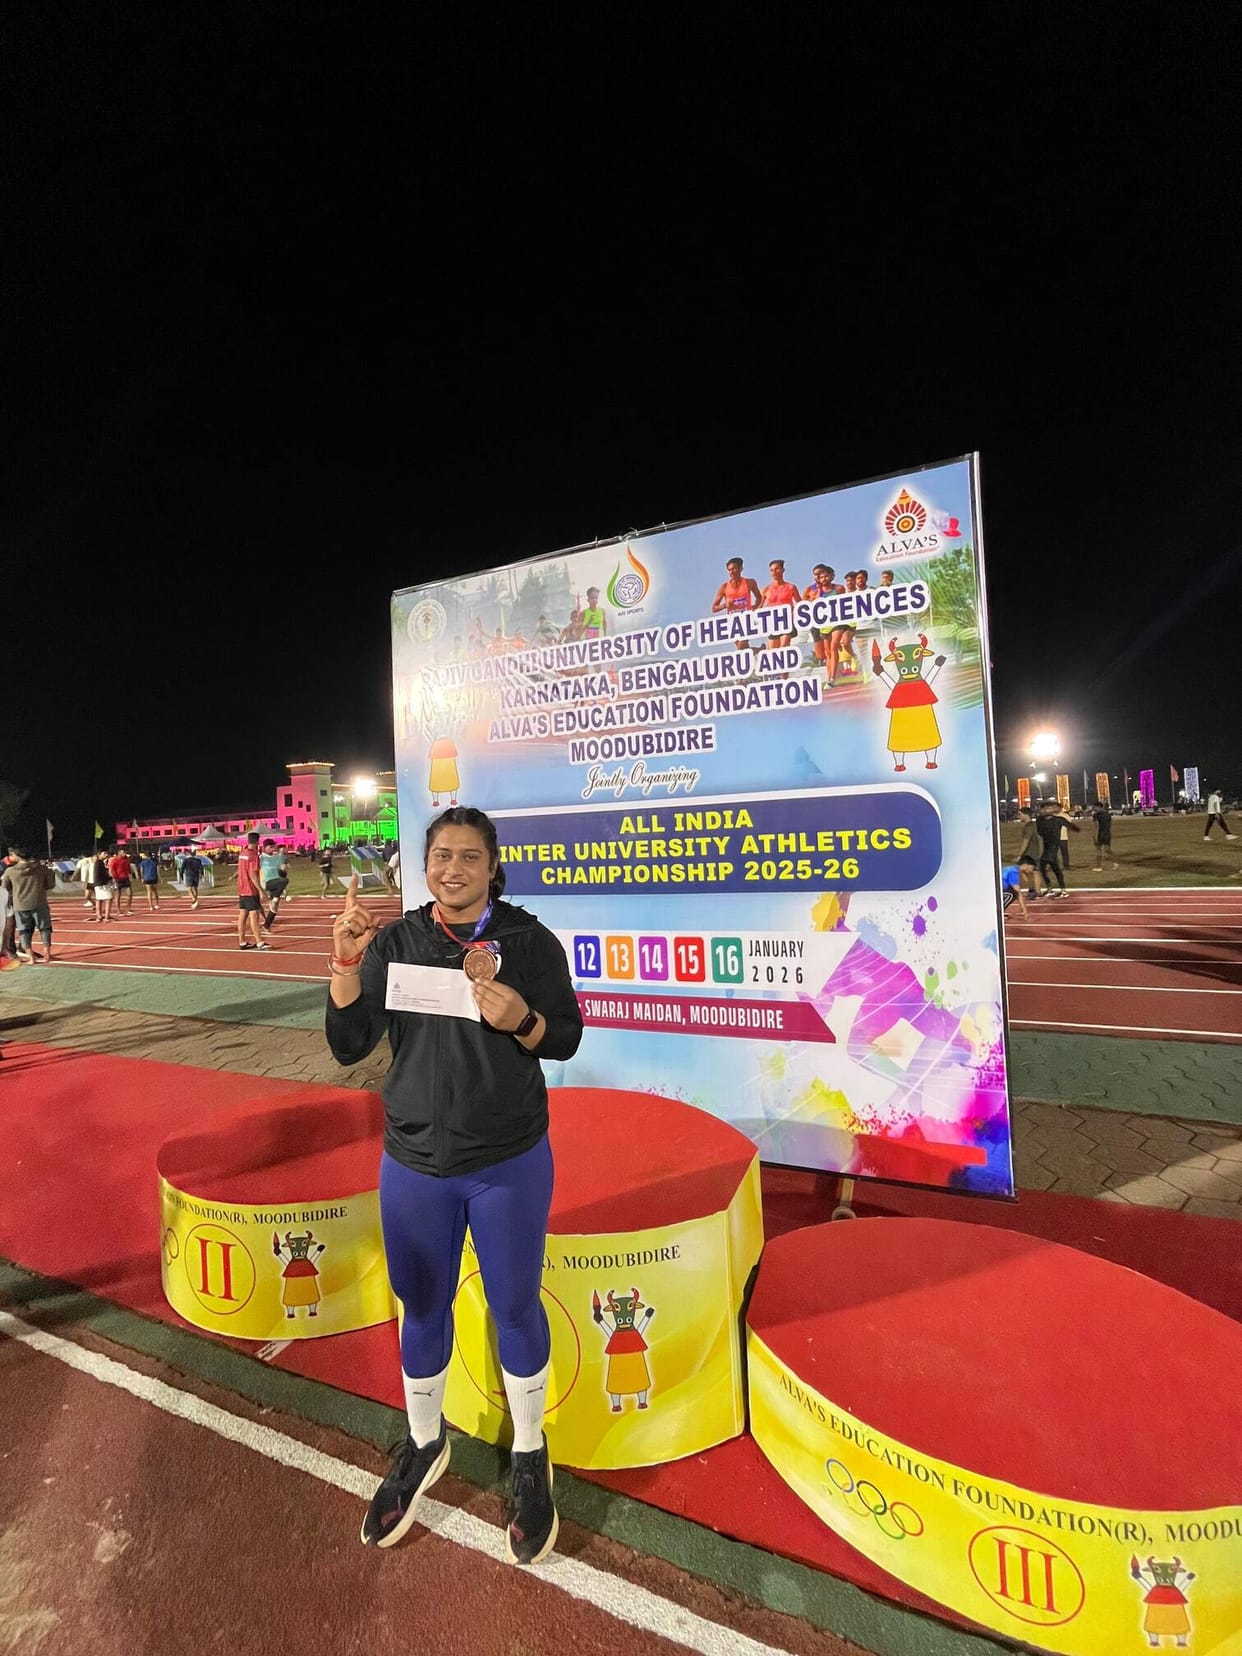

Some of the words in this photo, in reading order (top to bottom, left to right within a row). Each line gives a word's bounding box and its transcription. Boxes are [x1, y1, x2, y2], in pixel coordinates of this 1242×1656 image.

[876, 534, 938, 556] ALVA'S
[543, 630, 659, 670] UNIVERSITY
[665, 624, 692, 649] OF
[700, 607, 789, 644] HEALTH
[797, 584, 926, 627] SCIENCES
[501, 674, 616, 709] KARNATAKA,
[621, 652, 750, 692] BENGALURU
[759, 649, 800, 673] AND
[490, 714, 548, 741] ALVA'S
[554, 699, 665, 732] EDUCATION
[671, 678, 819, 719] FOUNDATION
[571, 727, 714, 762] MOODUBIDIRE
[583, 766, 627, 797] Jointly
[630, 762, 697, 794] Organizing
[619, 815, 666, 834] ALL
[674, 809, 754, 832] INDIA
[500, 843, 566, 863] INTER
[574, 836, 730, 861] UNIVERSITY
[740, 828, 912, 855] ATHLETICS
[541, 862, 734, 885] CHAMPIONSHIP
[744, 858, 860, 881] 2025-26
[577, 942, 597, 971] 12
[610, 943, 629, 972] 13
[641, 944, 663, 973] 14
[677, 944, 699, 975] 15
[715, 944, 739, 976] 16
[749, 940, 804, 958] JANUARY
[585, 999, 629, 1019] SWARAJ
[633, 1002, 686, 1026] MAIDAN,
[690, 1005, 784, 1030] MOODUBIDIRE
[253, 1205, 348, 1225] MOODUBIDIRE
[194, 1236, 239, 1302] II
[562, 1245, 681, 1270] MOODUBIDIRE
[780, 1374, 826, 1422] ALVA'S
[831, 1413, 945, 1491] EDUCATION
[953, 1480, 1153, 1545] FOUNDATION(R),
[992, 1537, 1061, 1615] III
